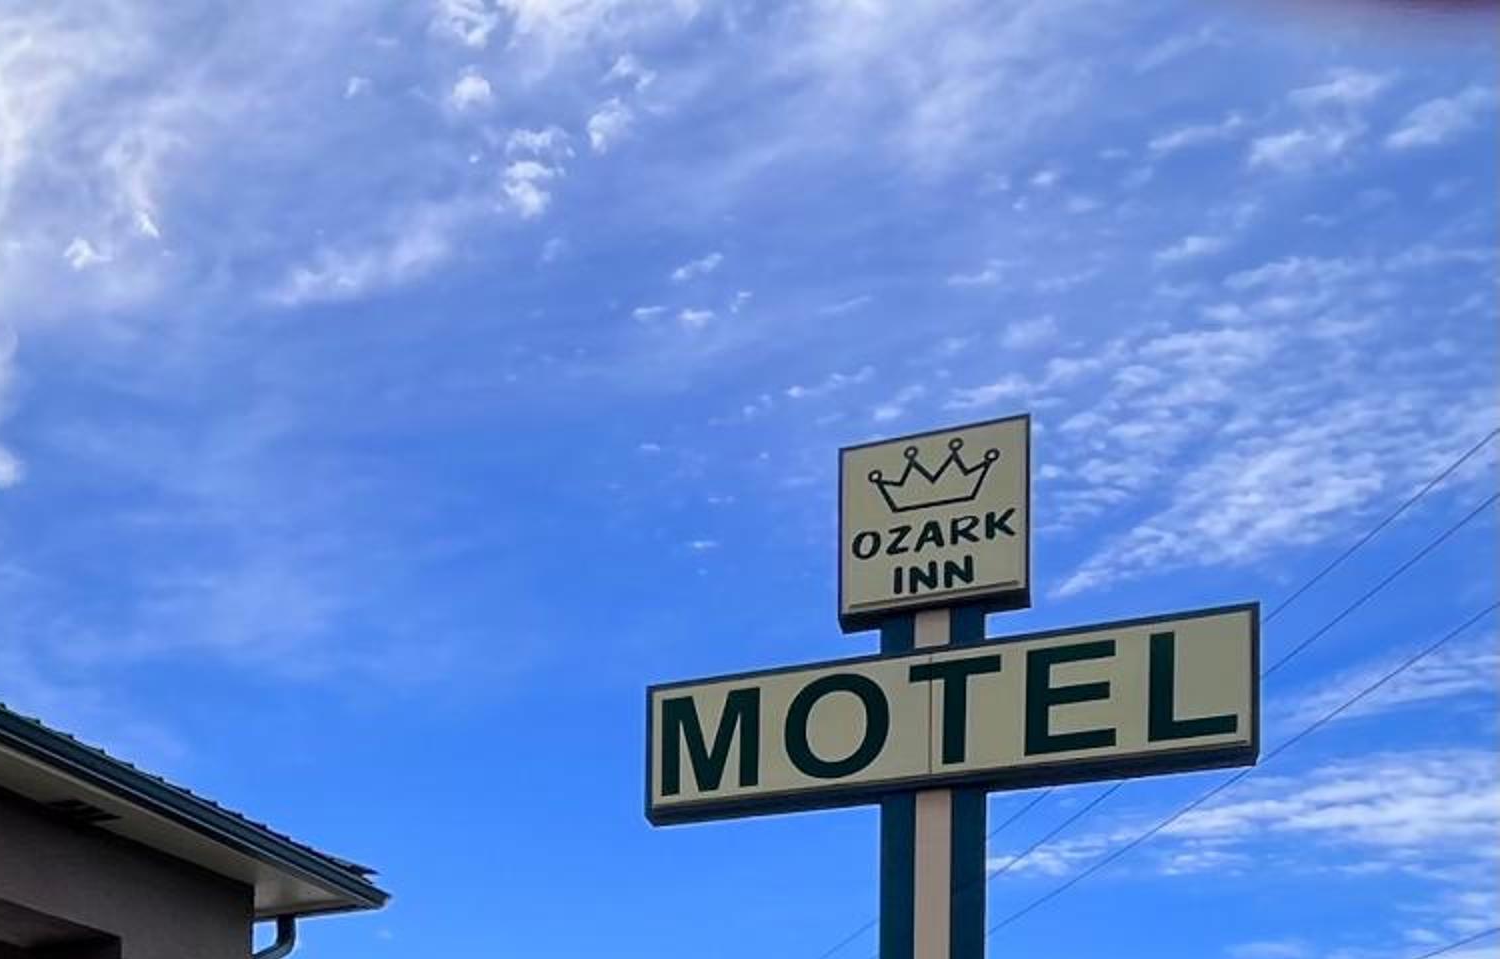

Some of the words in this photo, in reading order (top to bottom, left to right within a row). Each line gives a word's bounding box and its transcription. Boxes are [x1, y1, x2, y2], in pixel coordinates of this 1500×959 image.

[851, 506, 1017, 560] OZARK
[892, 554, 975, 595] INN
[660, 631, 1238, 797] MOTEL
